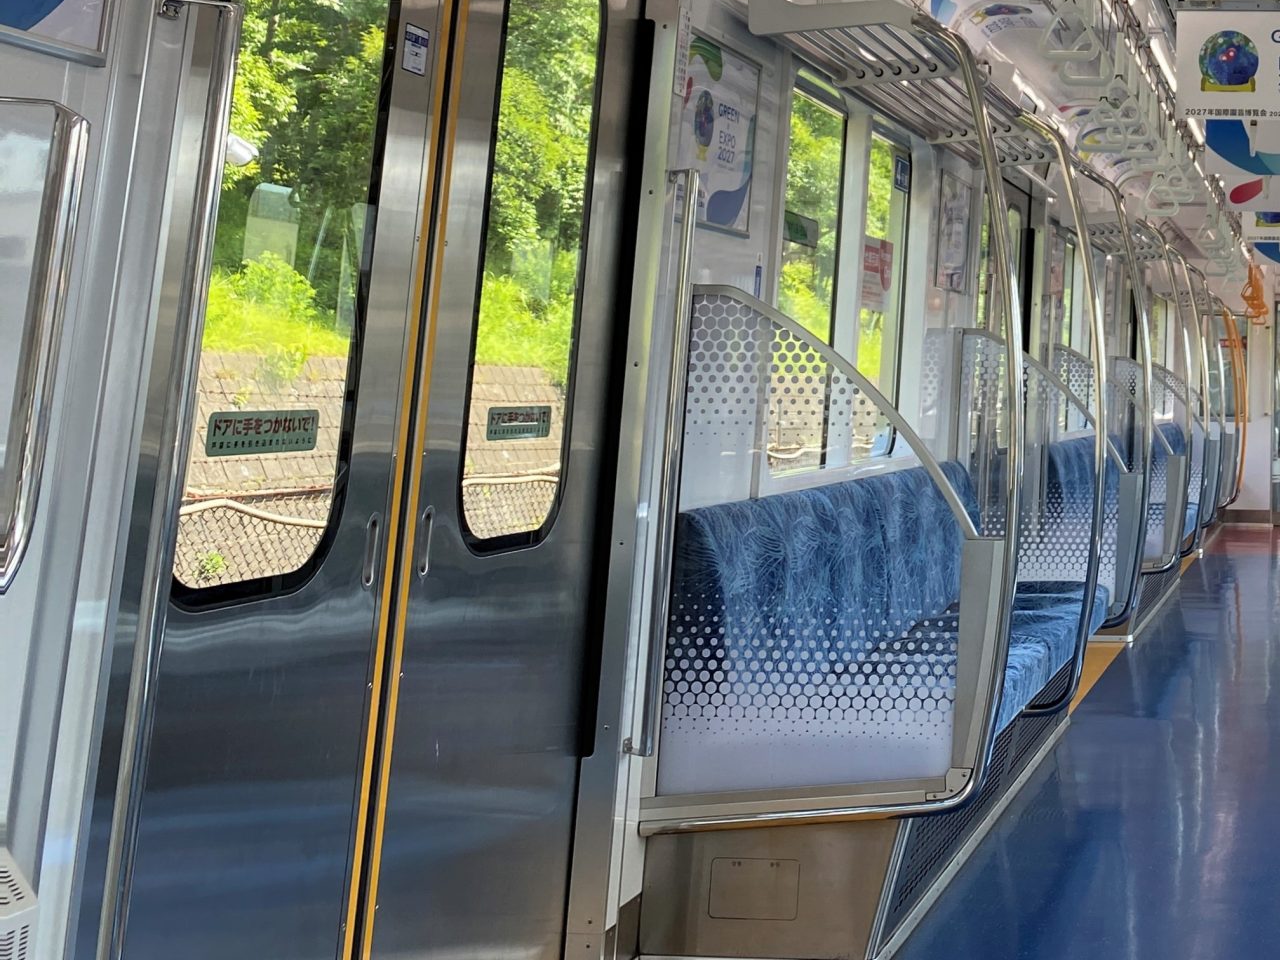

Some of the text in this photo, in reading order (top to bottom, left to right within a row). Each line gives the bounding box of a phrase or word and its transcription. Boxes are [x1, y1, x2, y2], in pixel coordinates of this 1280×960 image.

[718, 102, 740, 125] GREEN
[718, 130, 737, 149] EXPO
[717, 145, 735, 165] 2027
